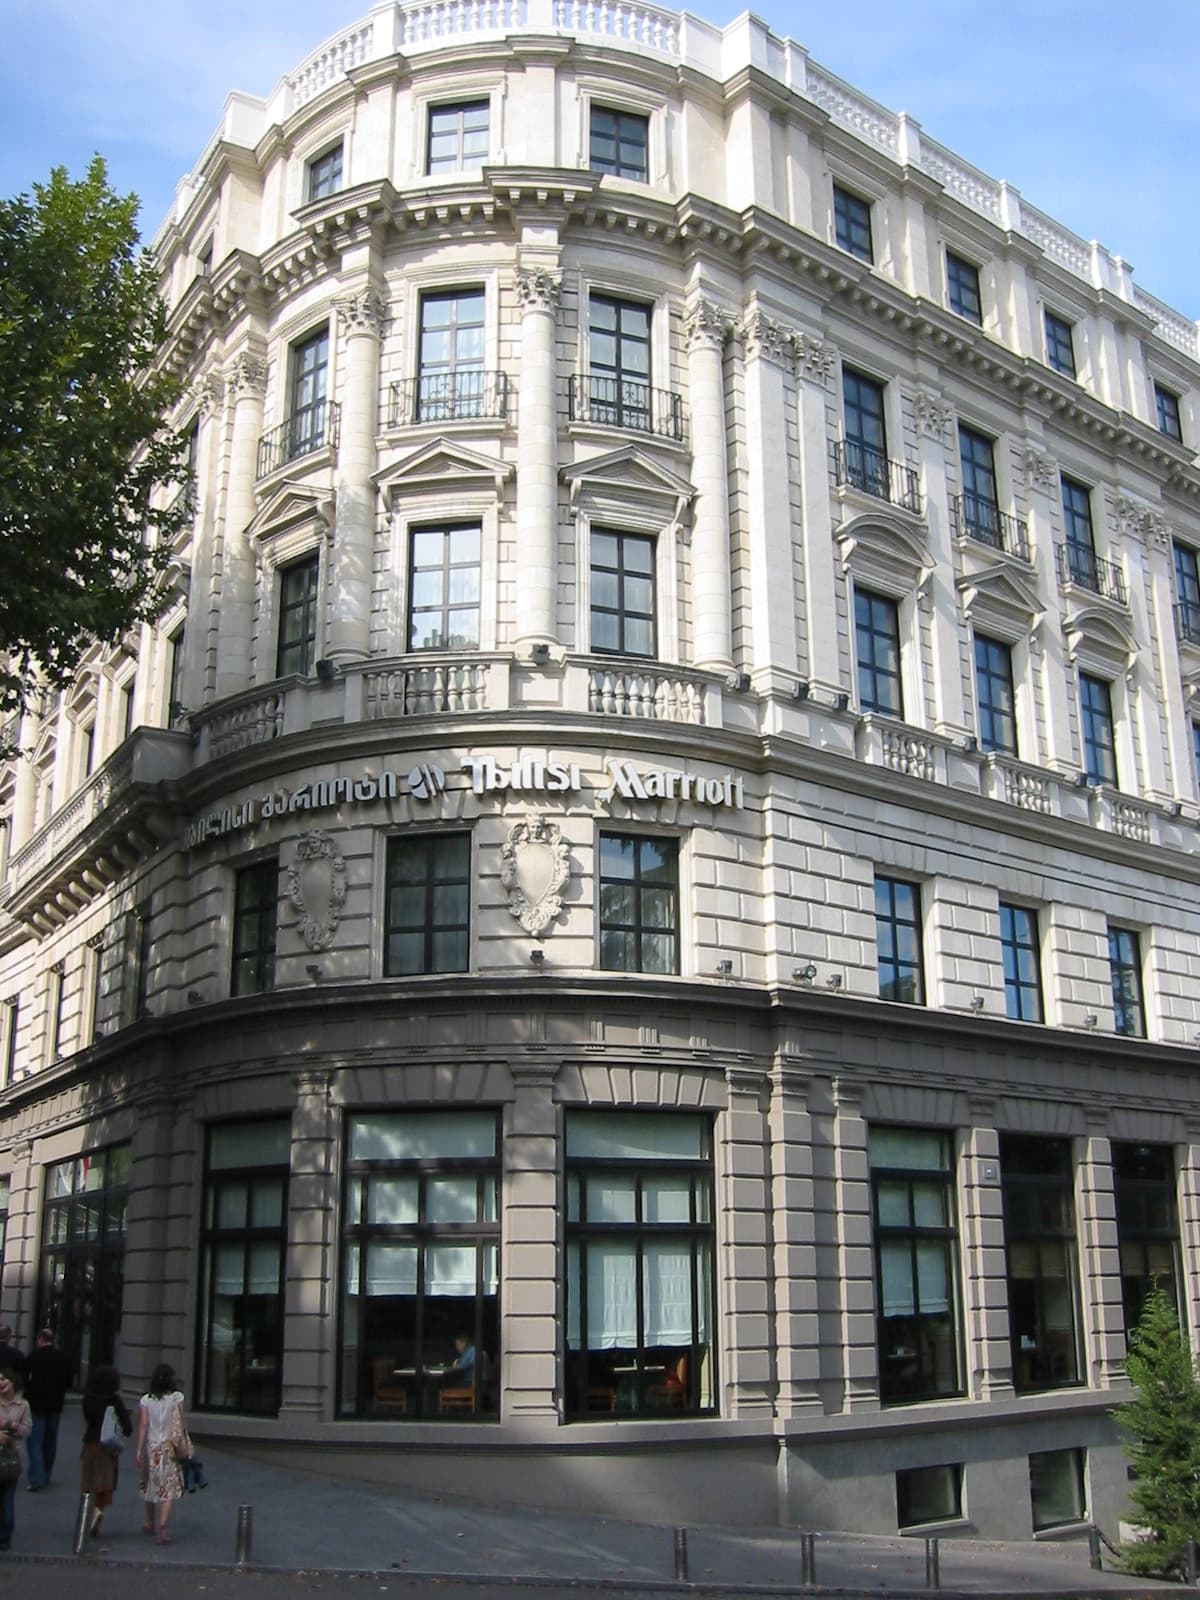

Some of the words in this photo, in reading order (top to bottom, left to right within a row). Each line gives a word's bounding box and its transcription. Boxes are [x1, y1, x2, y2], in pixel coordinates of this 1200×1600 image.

[261, 770, 397, 818] მარიოტი
[460, 754, 582, 795] Tbilisi
[598, 759, 745, 810] Marriott
